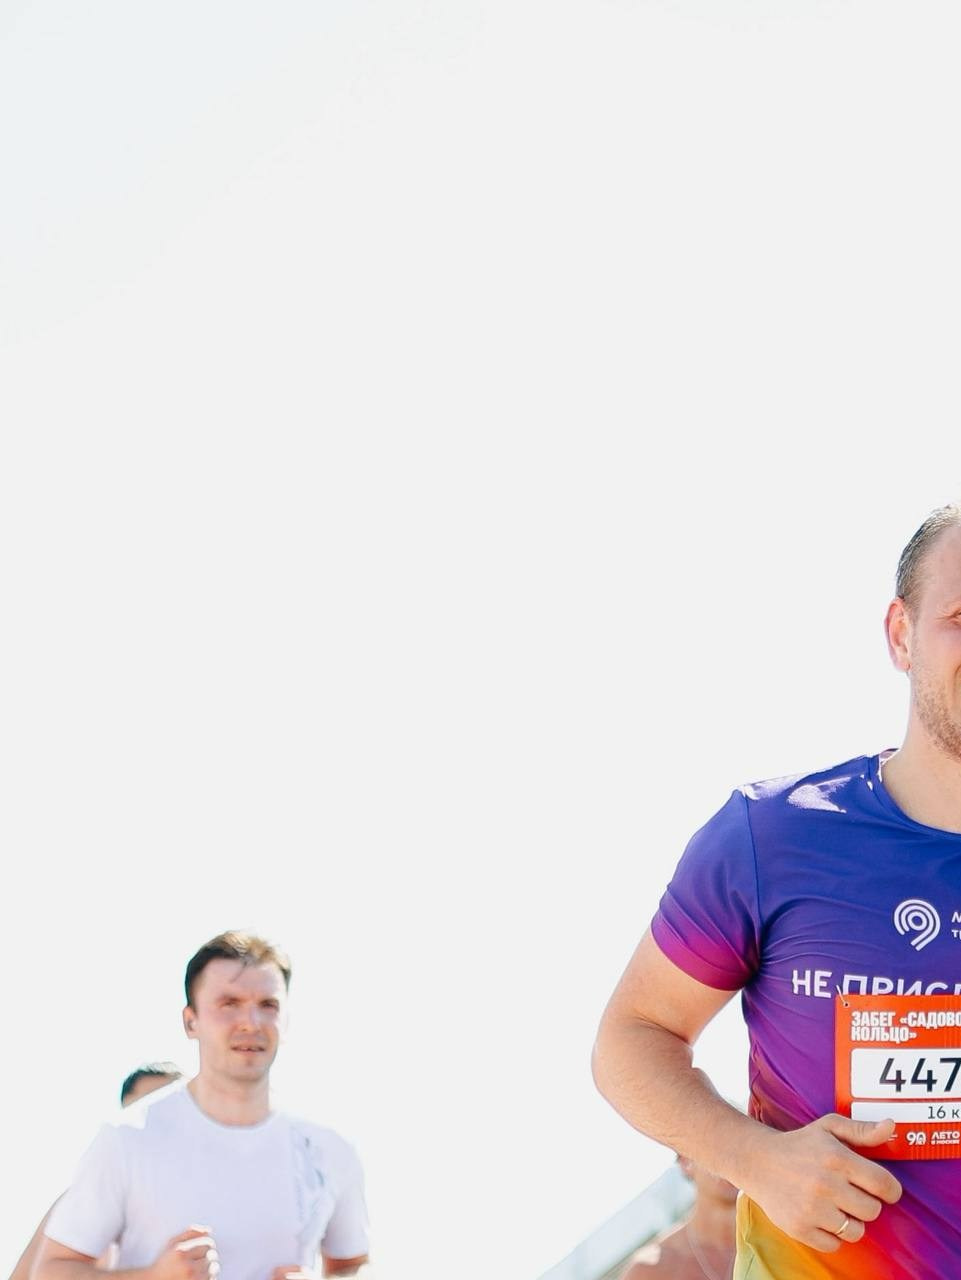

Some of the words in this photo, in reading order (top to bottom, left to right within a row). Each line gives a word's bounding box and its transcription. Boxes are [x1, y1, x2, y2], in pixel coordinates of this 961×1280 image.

[792, 969, 833, 999] НЕ
[851, 1011, 896, 1027] ЗАБЕГ
[851, 1026, 917, 1043] КОЛЬЦО»
[927, 1105, 946, 1120] 16
[931, 1131, 960, 1140] ЛЕТО
